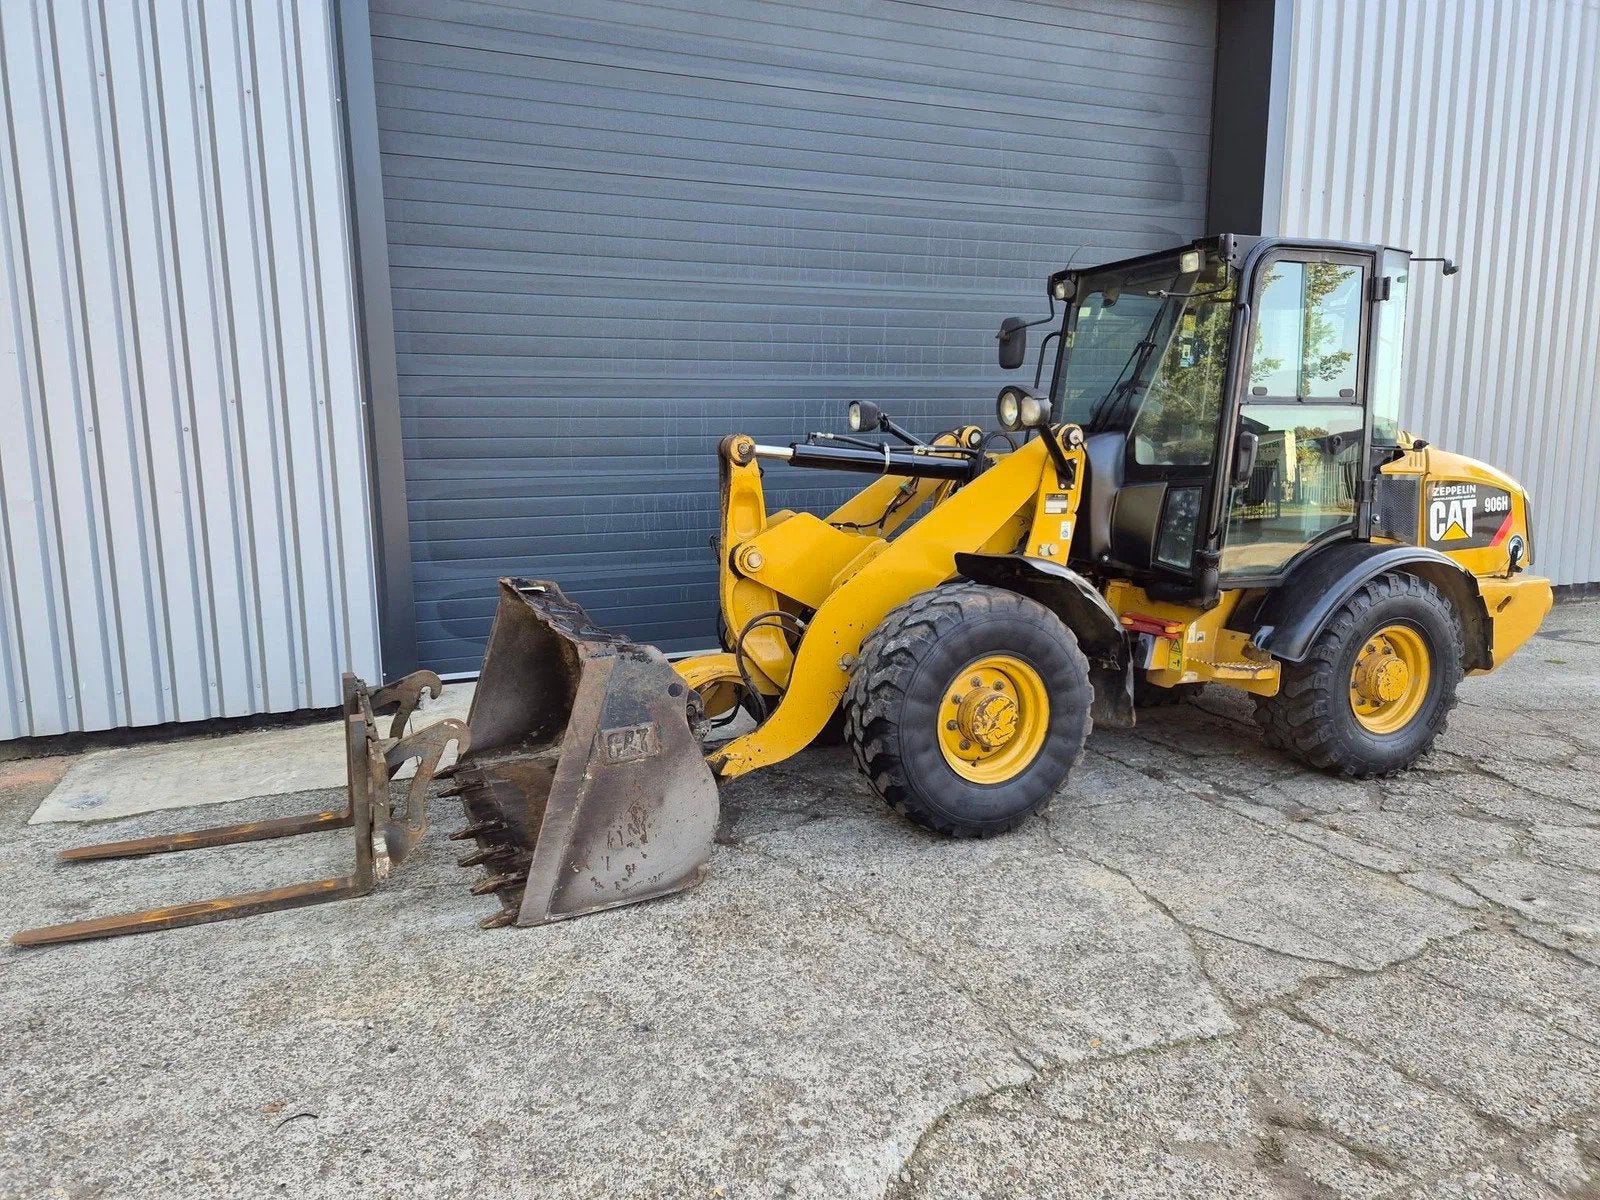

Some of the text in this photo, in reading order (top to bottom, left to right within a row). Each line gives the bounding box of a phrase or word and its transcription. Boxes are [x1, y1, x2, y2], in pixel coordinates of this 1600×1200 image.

[1432, 485, 1476, 496] ZEPPELIN
[1484, 496, 1508, 512] 906H
[1430, 499, 1477, 541] CAT
[607, 727, 649, 760] CAT
